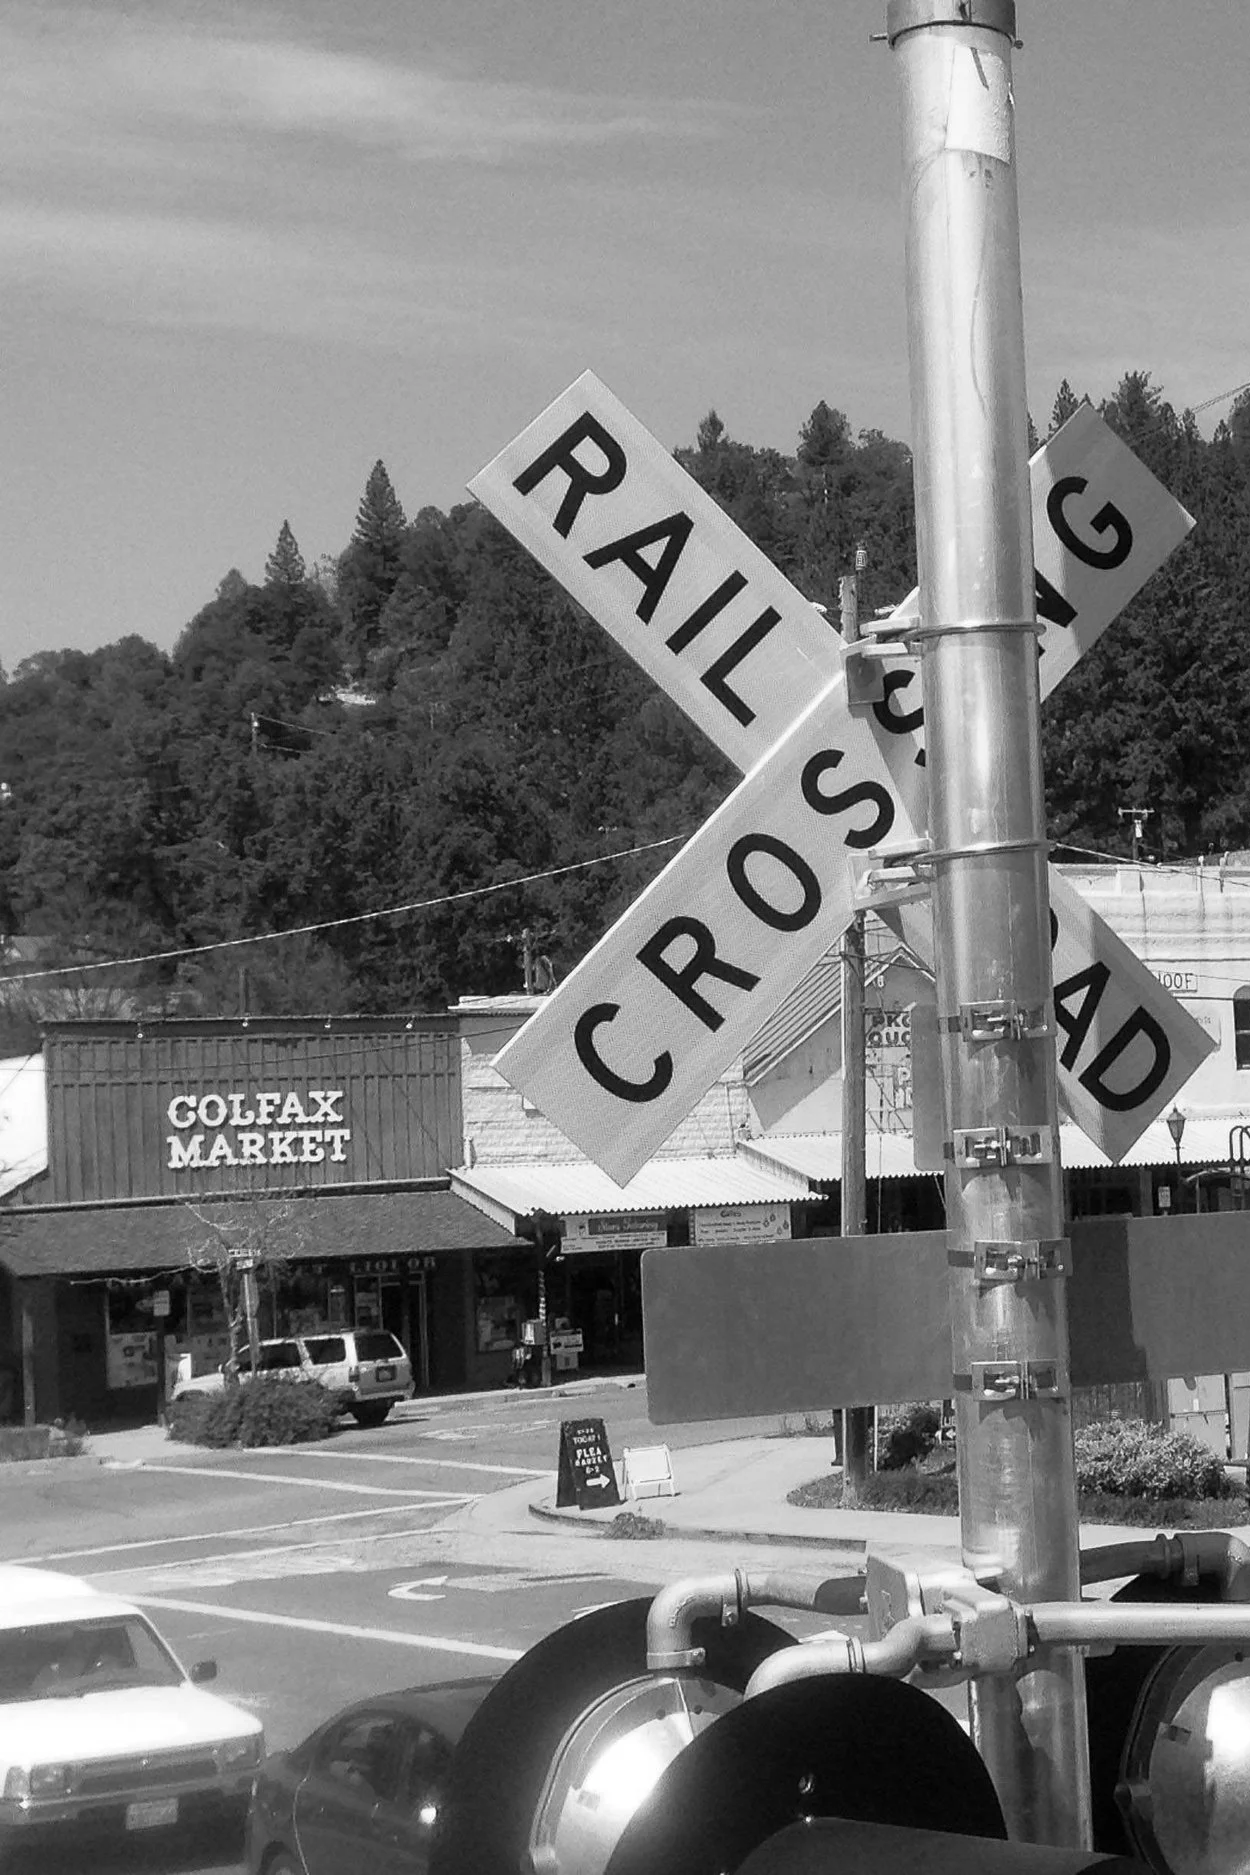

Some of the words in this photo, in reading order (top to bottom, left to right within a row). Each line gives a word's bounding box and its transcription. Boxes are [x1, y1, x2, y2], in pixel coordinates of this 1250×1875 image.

[512, 411, 782, 727] RAIL
[573, 475, 1133, 1103] CROSSG
[166, 1129, 350, 1169] MARKET
[167, 1090, 344, 1129] COLFAX
